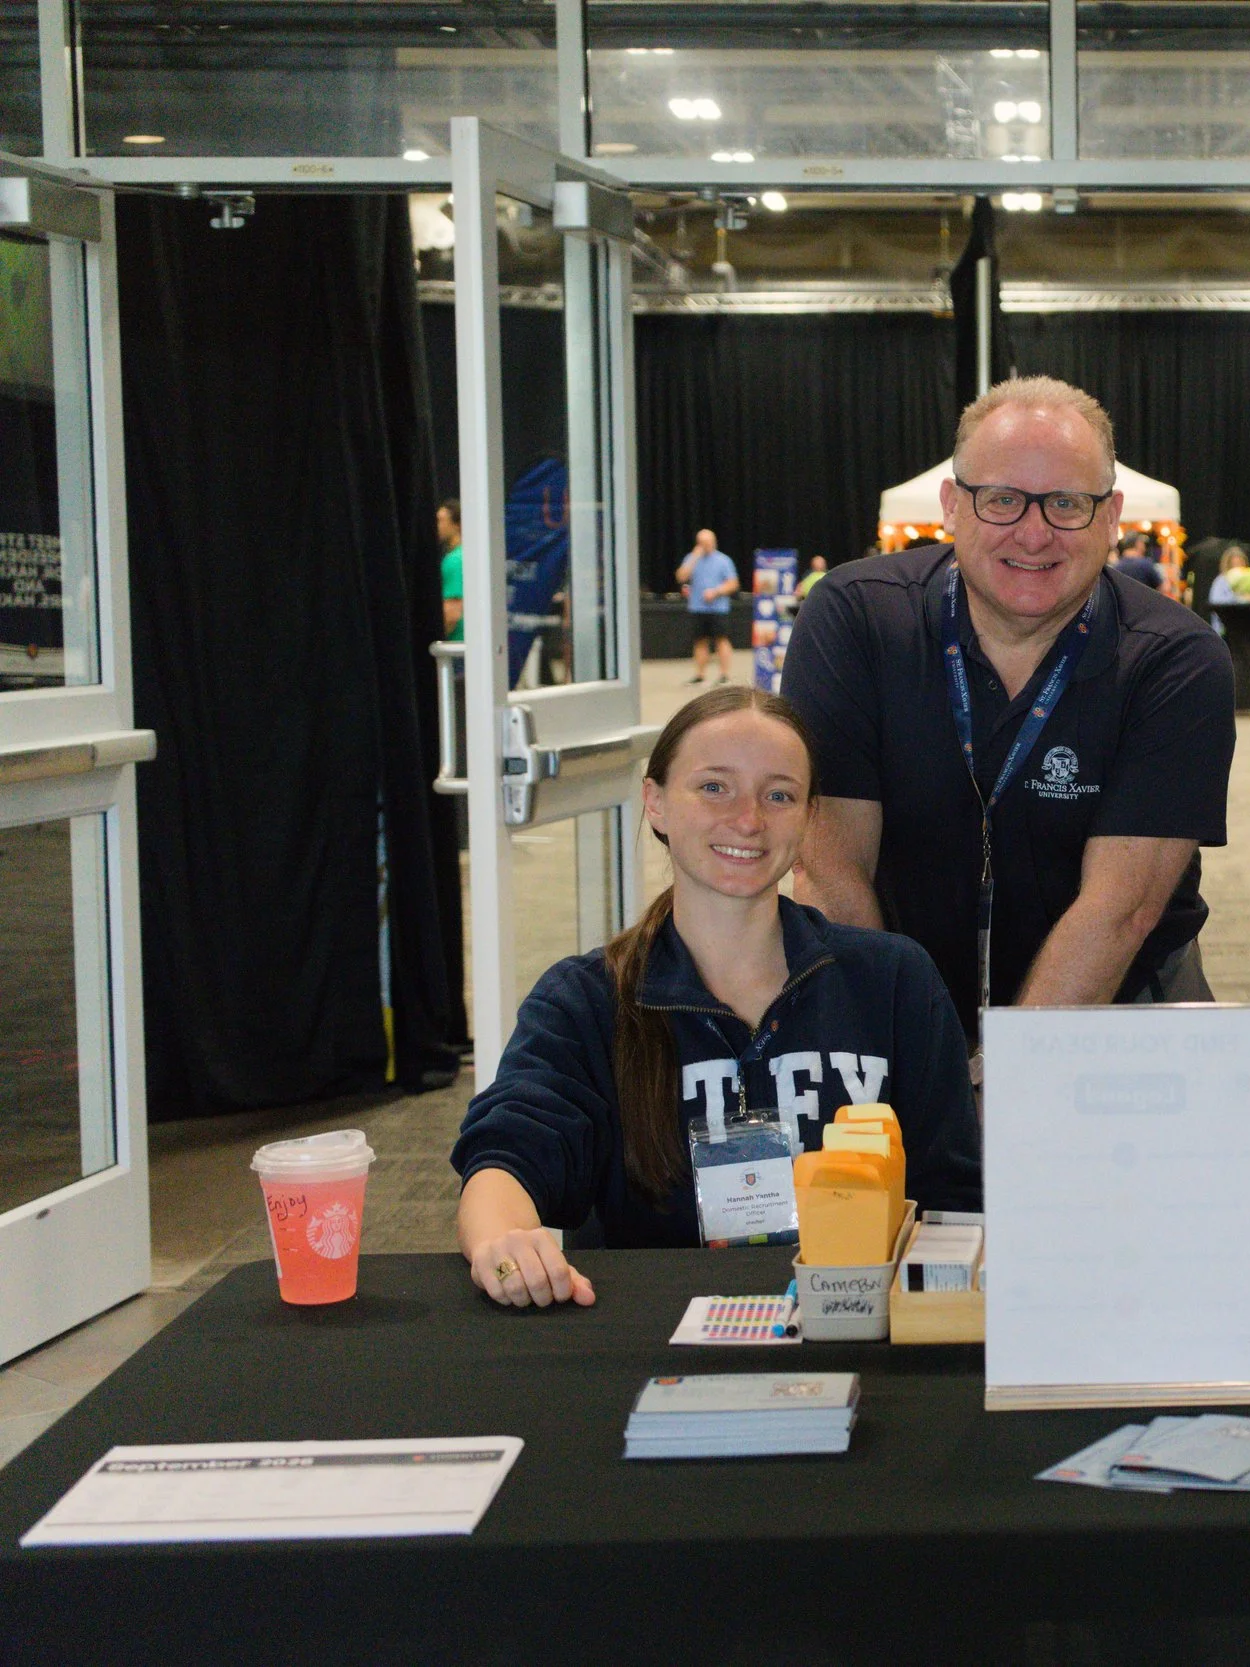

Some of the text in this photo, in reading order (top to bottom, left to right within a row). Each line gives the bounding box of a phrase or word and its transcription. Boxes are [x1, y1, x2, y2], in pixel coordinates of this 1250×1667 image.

[1031, 779, 1067, 793] FRANCIS
[1069, 783, 1101, 793] XAVIER
[1038, 791, 1079, 800] UNIVERSITY
[726, 1195, 754, 1204] Hannah
[751, 1200, 788, 1209] Recruitment
[267, 1194, 308, 1221] Enjoy
[106, 1459, 252, 1474] September
